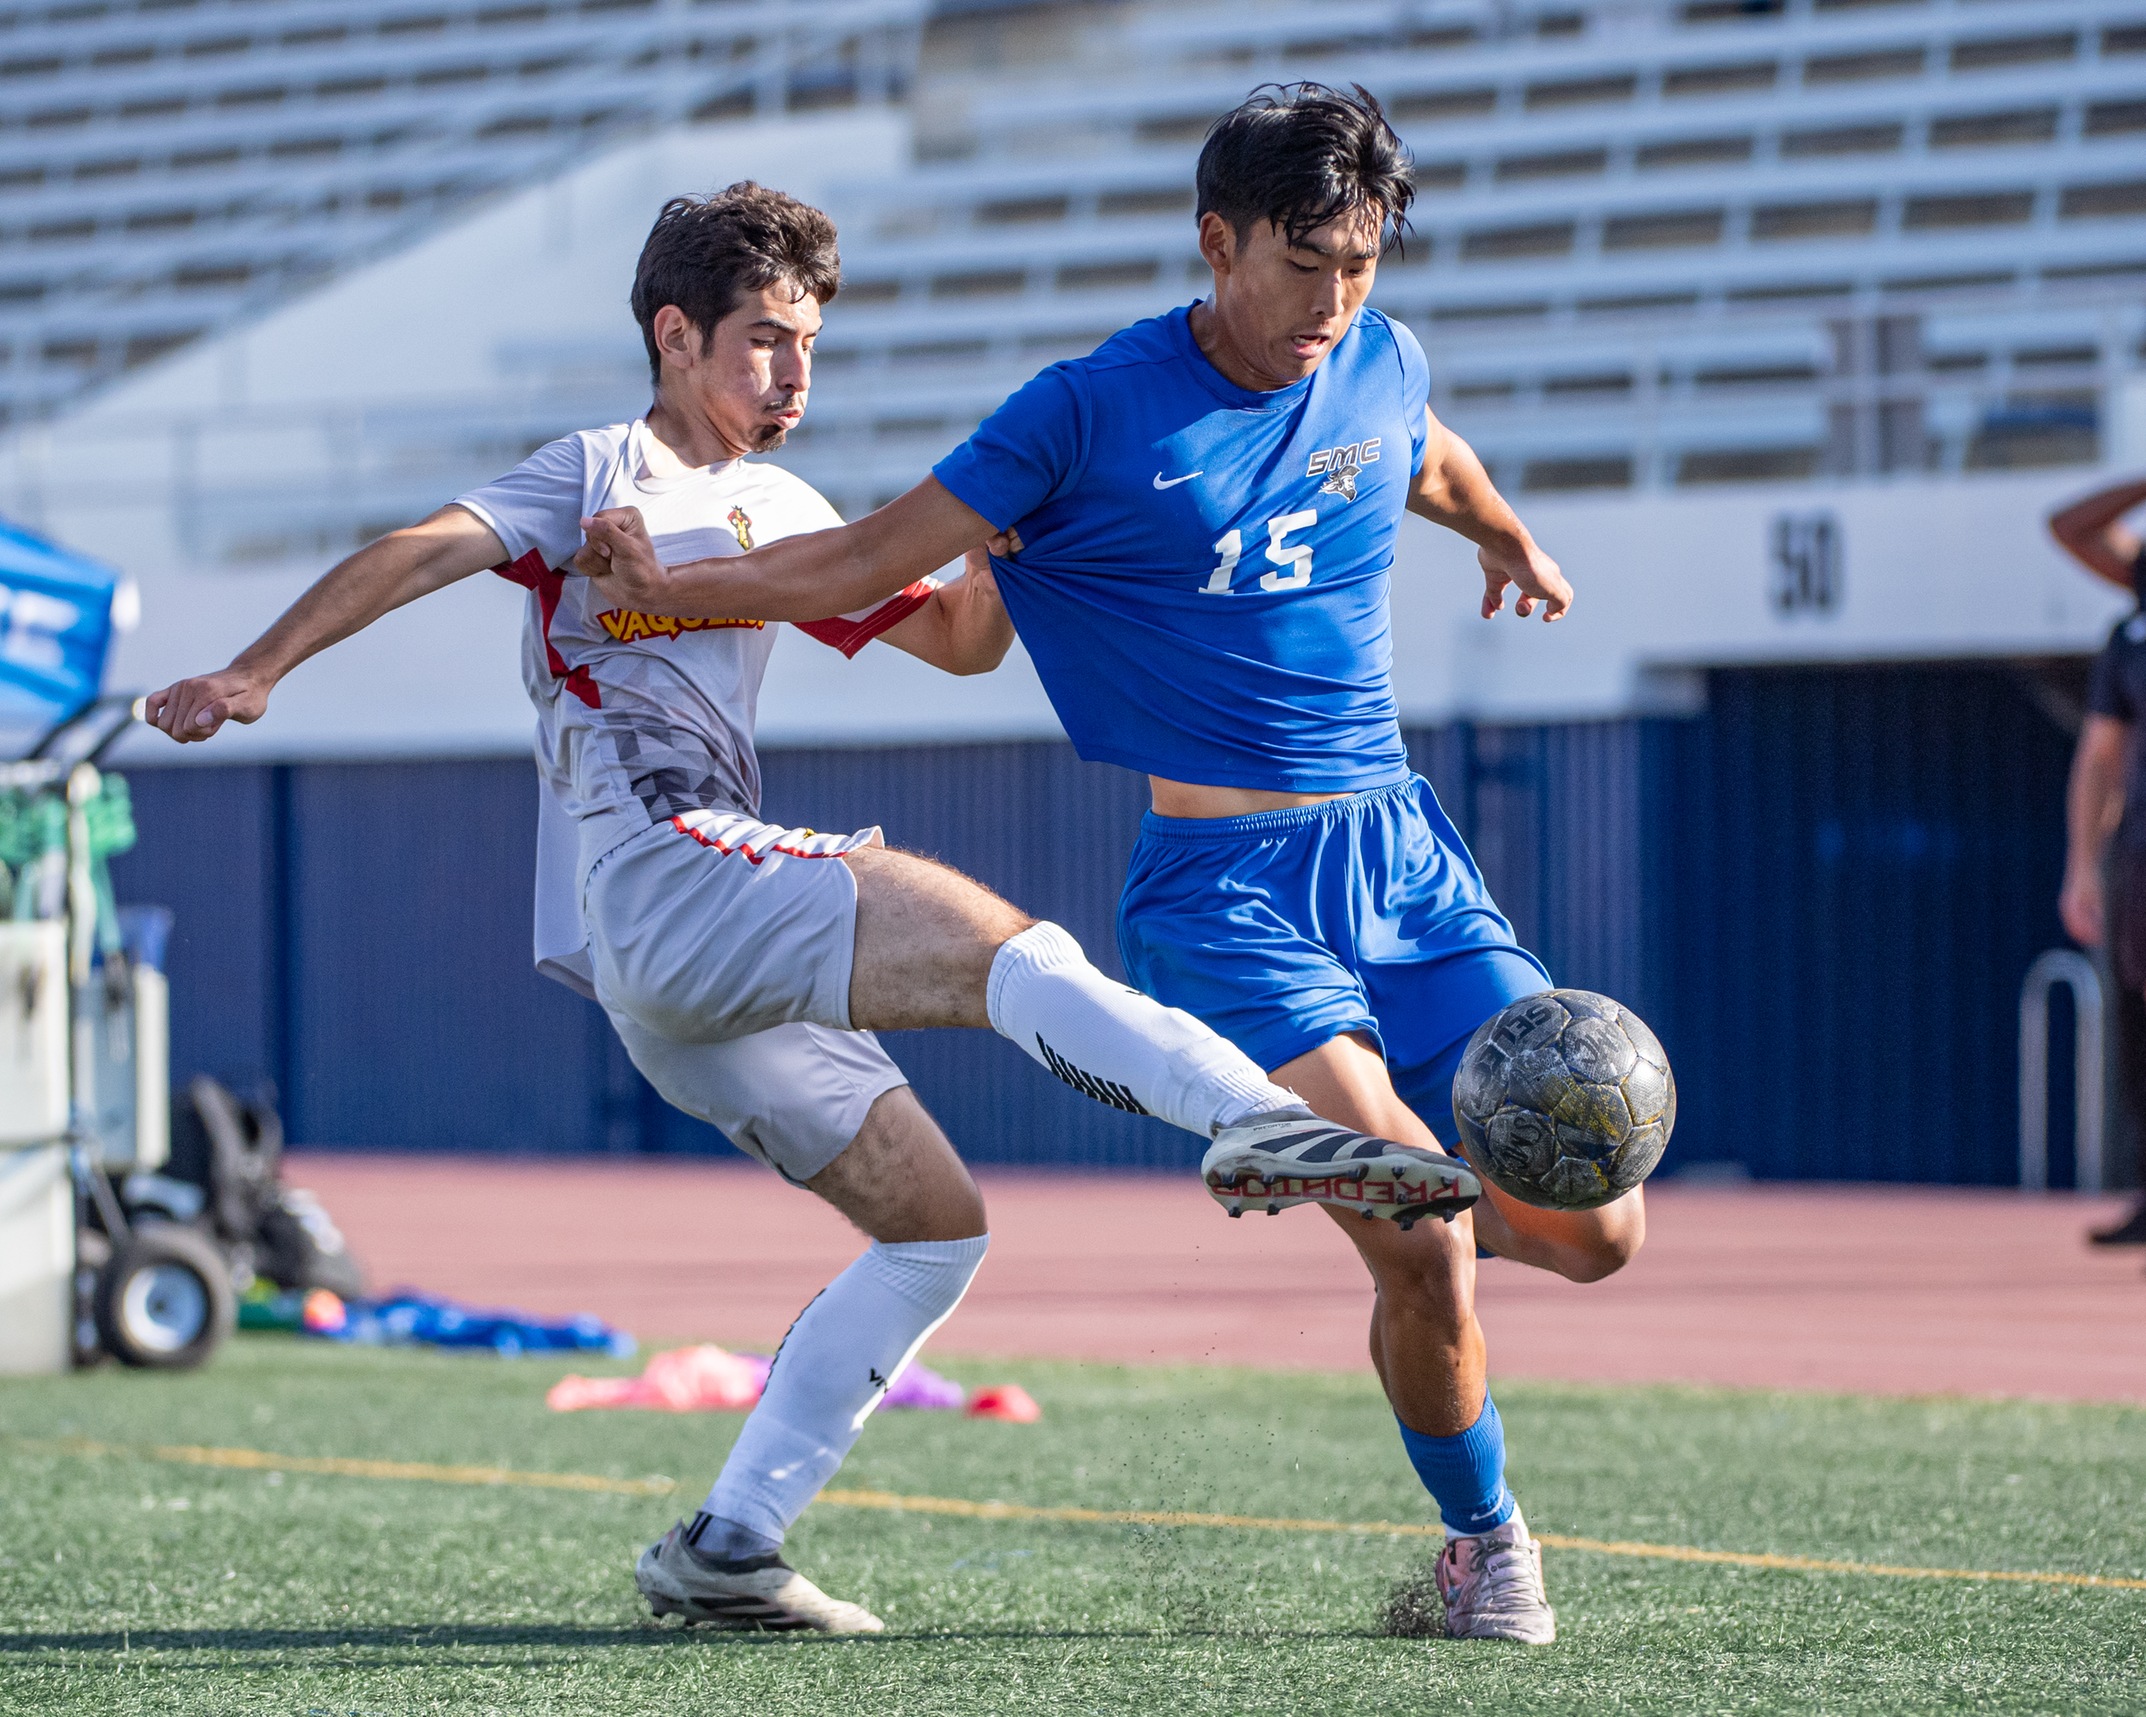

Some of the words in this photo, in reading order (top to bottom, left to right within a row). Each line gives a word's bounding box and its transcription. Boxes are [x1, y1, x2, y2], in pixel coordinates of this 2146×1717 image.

[1306, 437, 1382, 478] SMC
[1198, 509, 1318, 595] 15
[1770, 512, 1844, 617] 50
